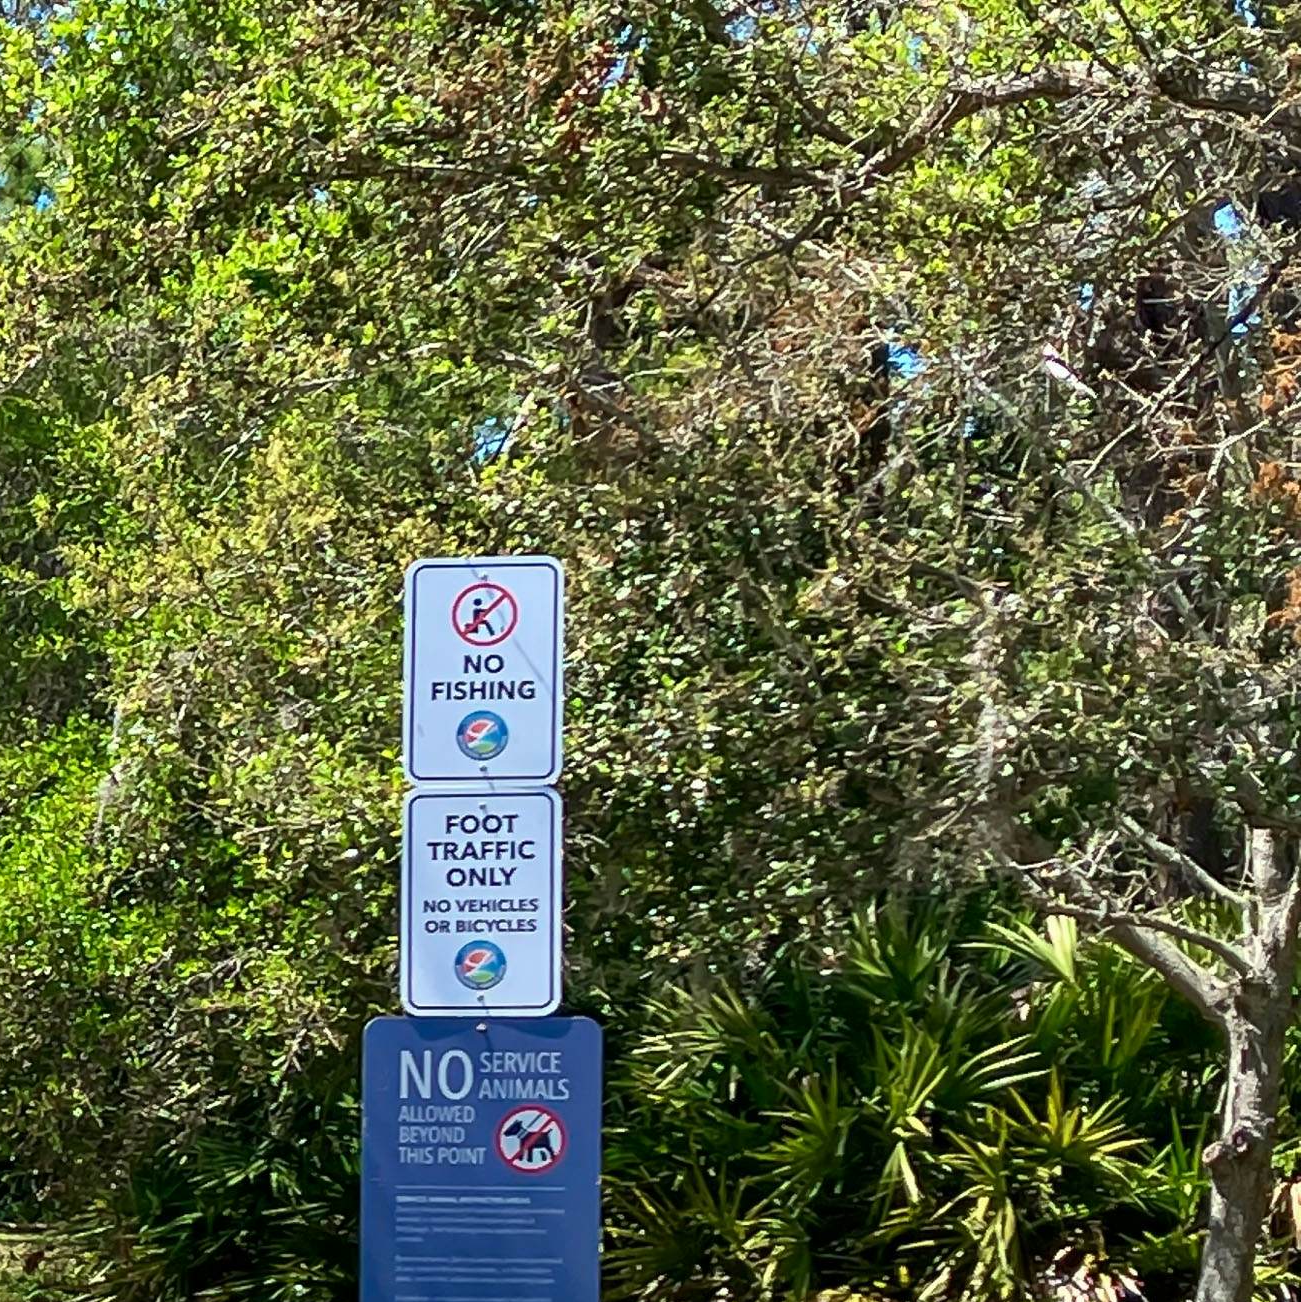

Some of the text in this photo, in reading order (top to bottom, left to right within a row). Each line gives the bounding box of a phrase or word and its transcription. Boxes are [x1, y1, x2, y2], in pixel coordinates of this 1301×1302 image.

[463, 654, 505, 674] NO
[431, 681, 536, 700] FISHING
[446, 814, 518, 834] FOOT
[427, 841, 536, 860] TRAFFIC
[447, 868, 517, 886] ONLY
[423, 899, 539, 913] NO VEHICLES
[425, 919, 537, 933] OR BICYCLES
[479, 1052, 561, 1074] SERVICE
[399, 1049, 474, 1100] NO
[478, 1078, 569, 1100] ANIMALS
[398, 1105, 475, 1123] ALLOWED
[399, 1126, 465, 1144] BEYOND
[399, 1147, 486, 1165] THIS POINT
